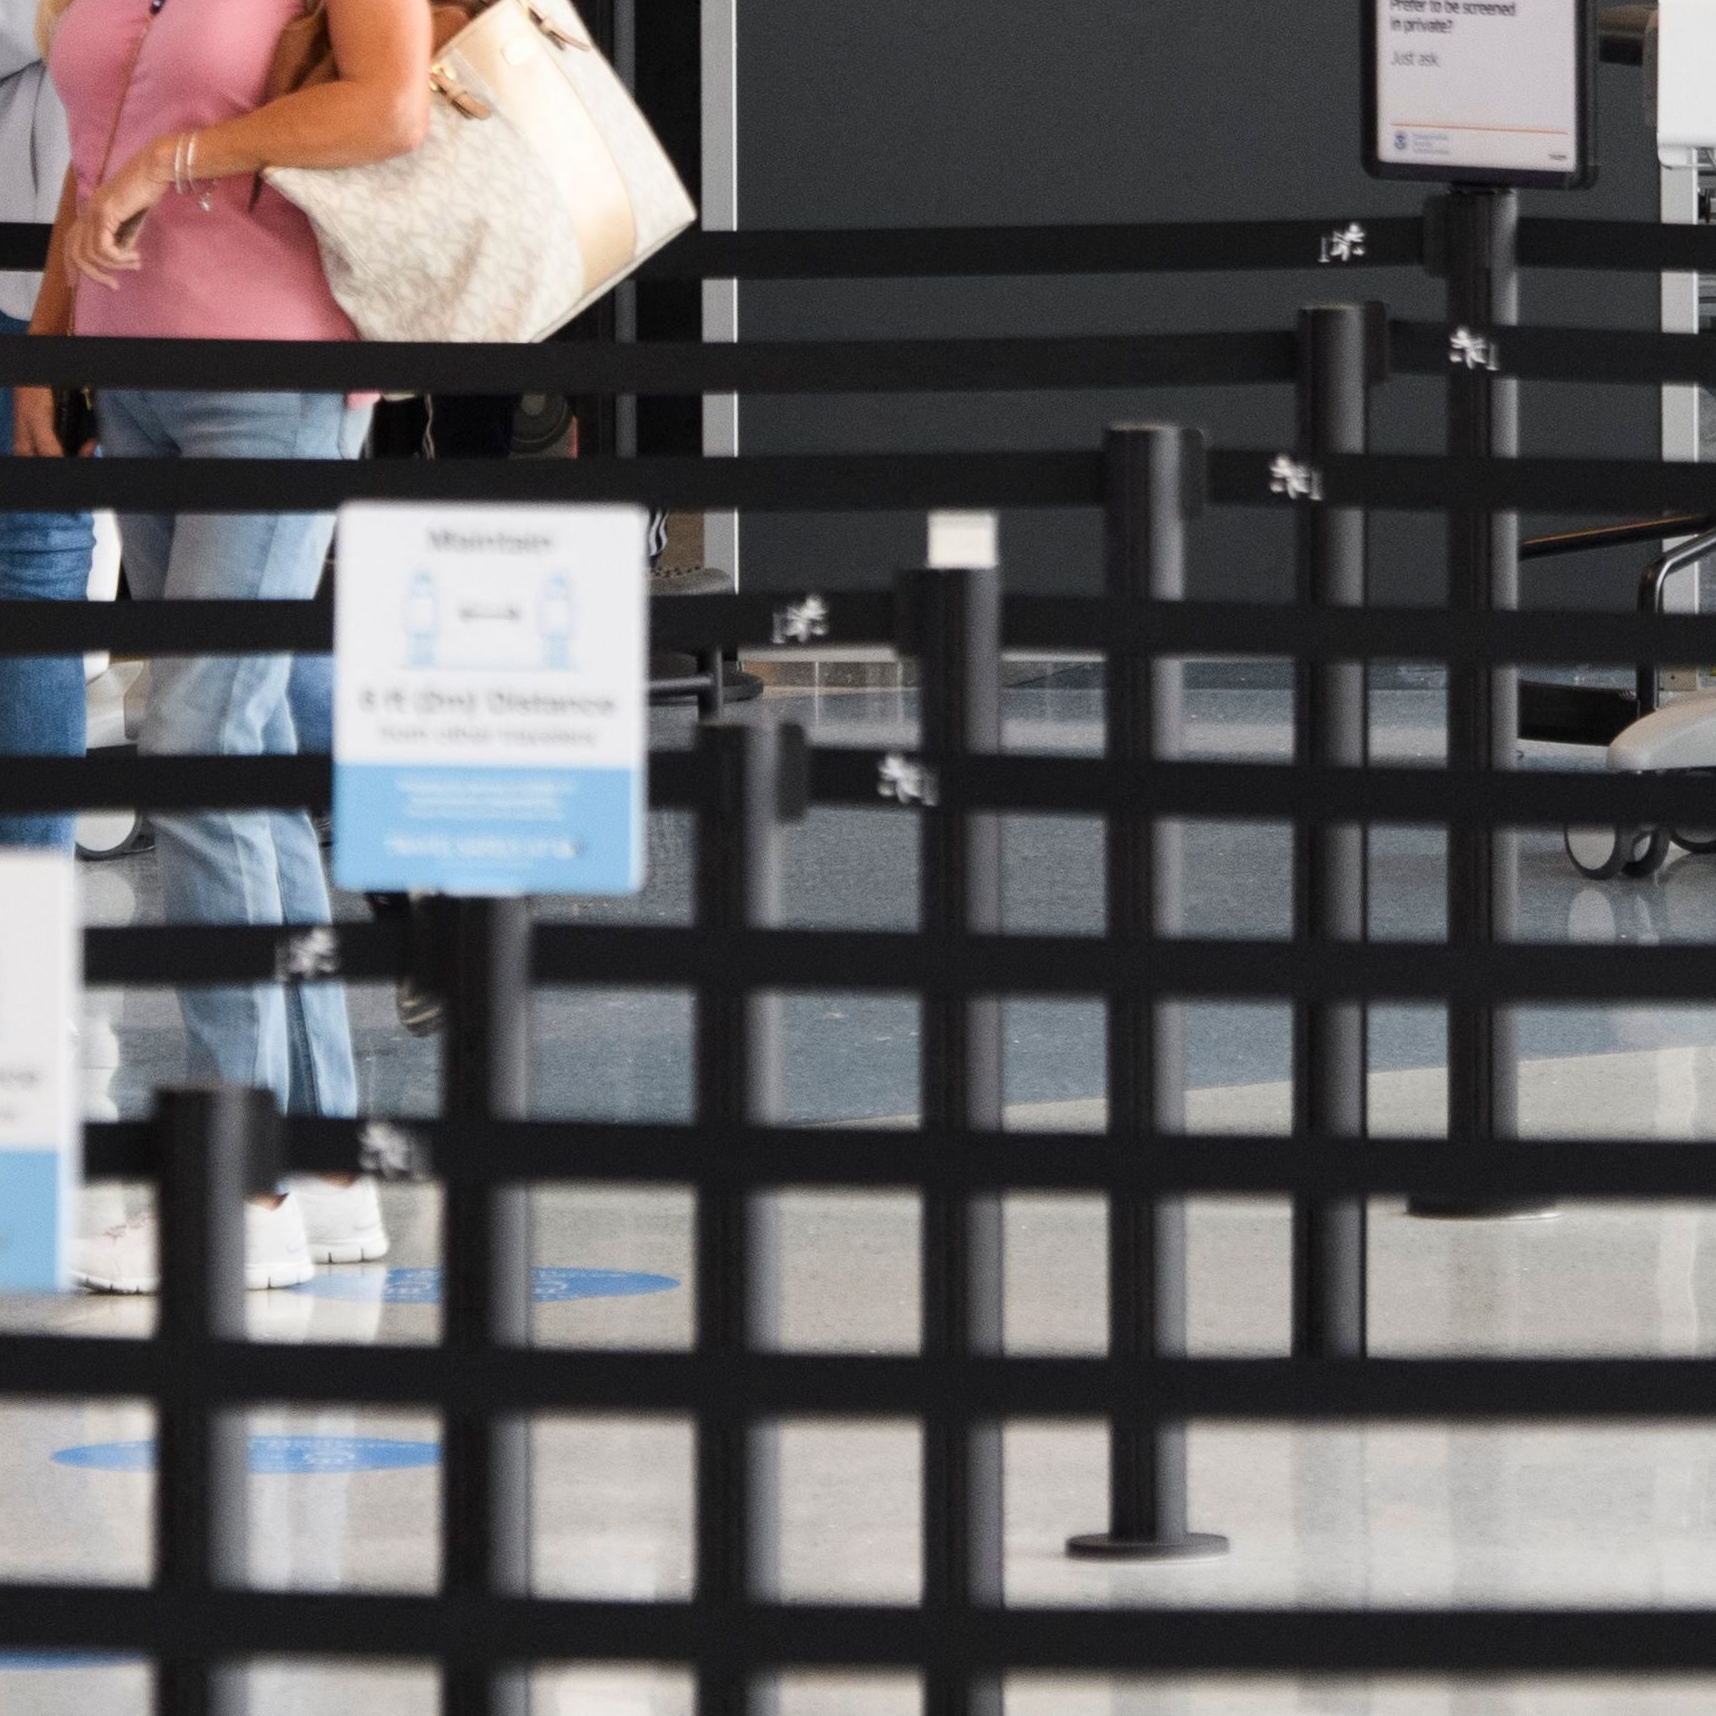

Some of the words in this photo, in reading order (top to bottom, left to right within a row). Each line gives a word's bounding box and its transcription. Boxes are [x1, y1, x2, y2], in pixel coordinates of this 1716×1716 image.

[1430, 0, 1442, 14] to
[1443, 0, 1460, 14] be
[1462, 0, 1517, 18] screened
[1390, 17, 1402, 32] in
[1403, 17, 1454, 34] private?
[1390, 50, 1416, 67] Just
